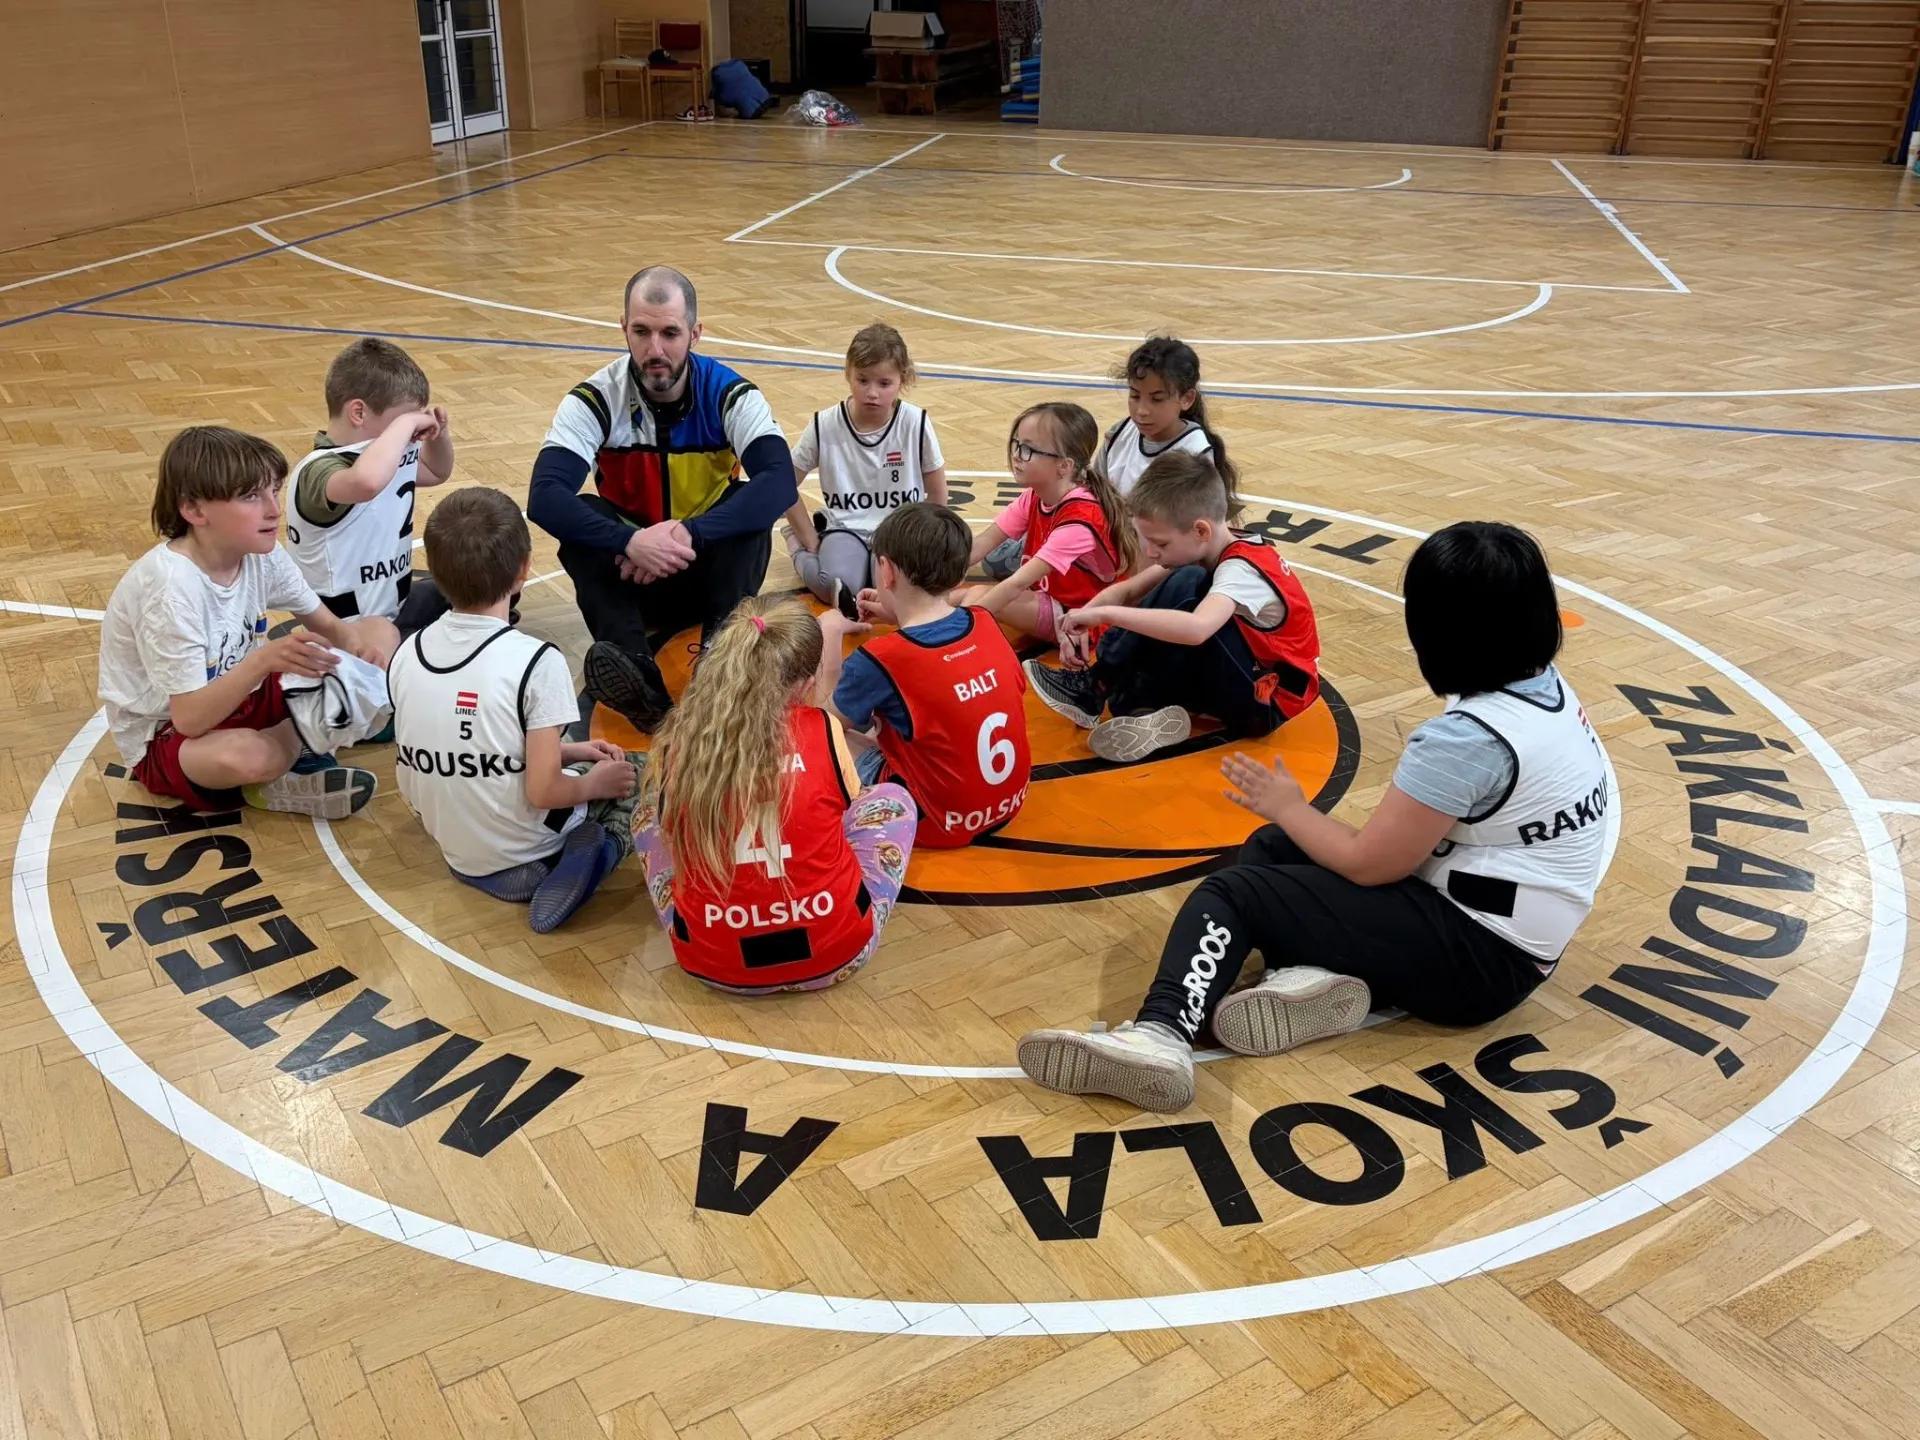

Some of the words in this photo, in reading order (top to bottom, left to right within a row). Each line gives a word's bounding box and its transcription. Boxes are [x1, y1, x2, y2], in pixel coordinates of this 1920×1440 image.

[891, 470, 899, 482] 8
[396, 480, 415, 540] 2
[360, 549, 412, 584] RAKOU
[455, 707, 477, 716] LINEC
[953, 668, 999, 702] BALT
[396, 743, 526, 778] AKOUSKO
[459, 721, 473, 740] 5
[977, 712, 1015, 785] 6
[1518, 770, 1607, 845] RAKOU
[735, 801, 792, 878] 4
[704, 891, 833, 928] POLSKO
[1579, 683, 1816, 1080] ZÁKLADNÍ
[96, 801, 585, 1158] MATEŘSK
[695, 1102, 839, 1216] A
[976, 1033, 1653, 1240] ŠKOLA
